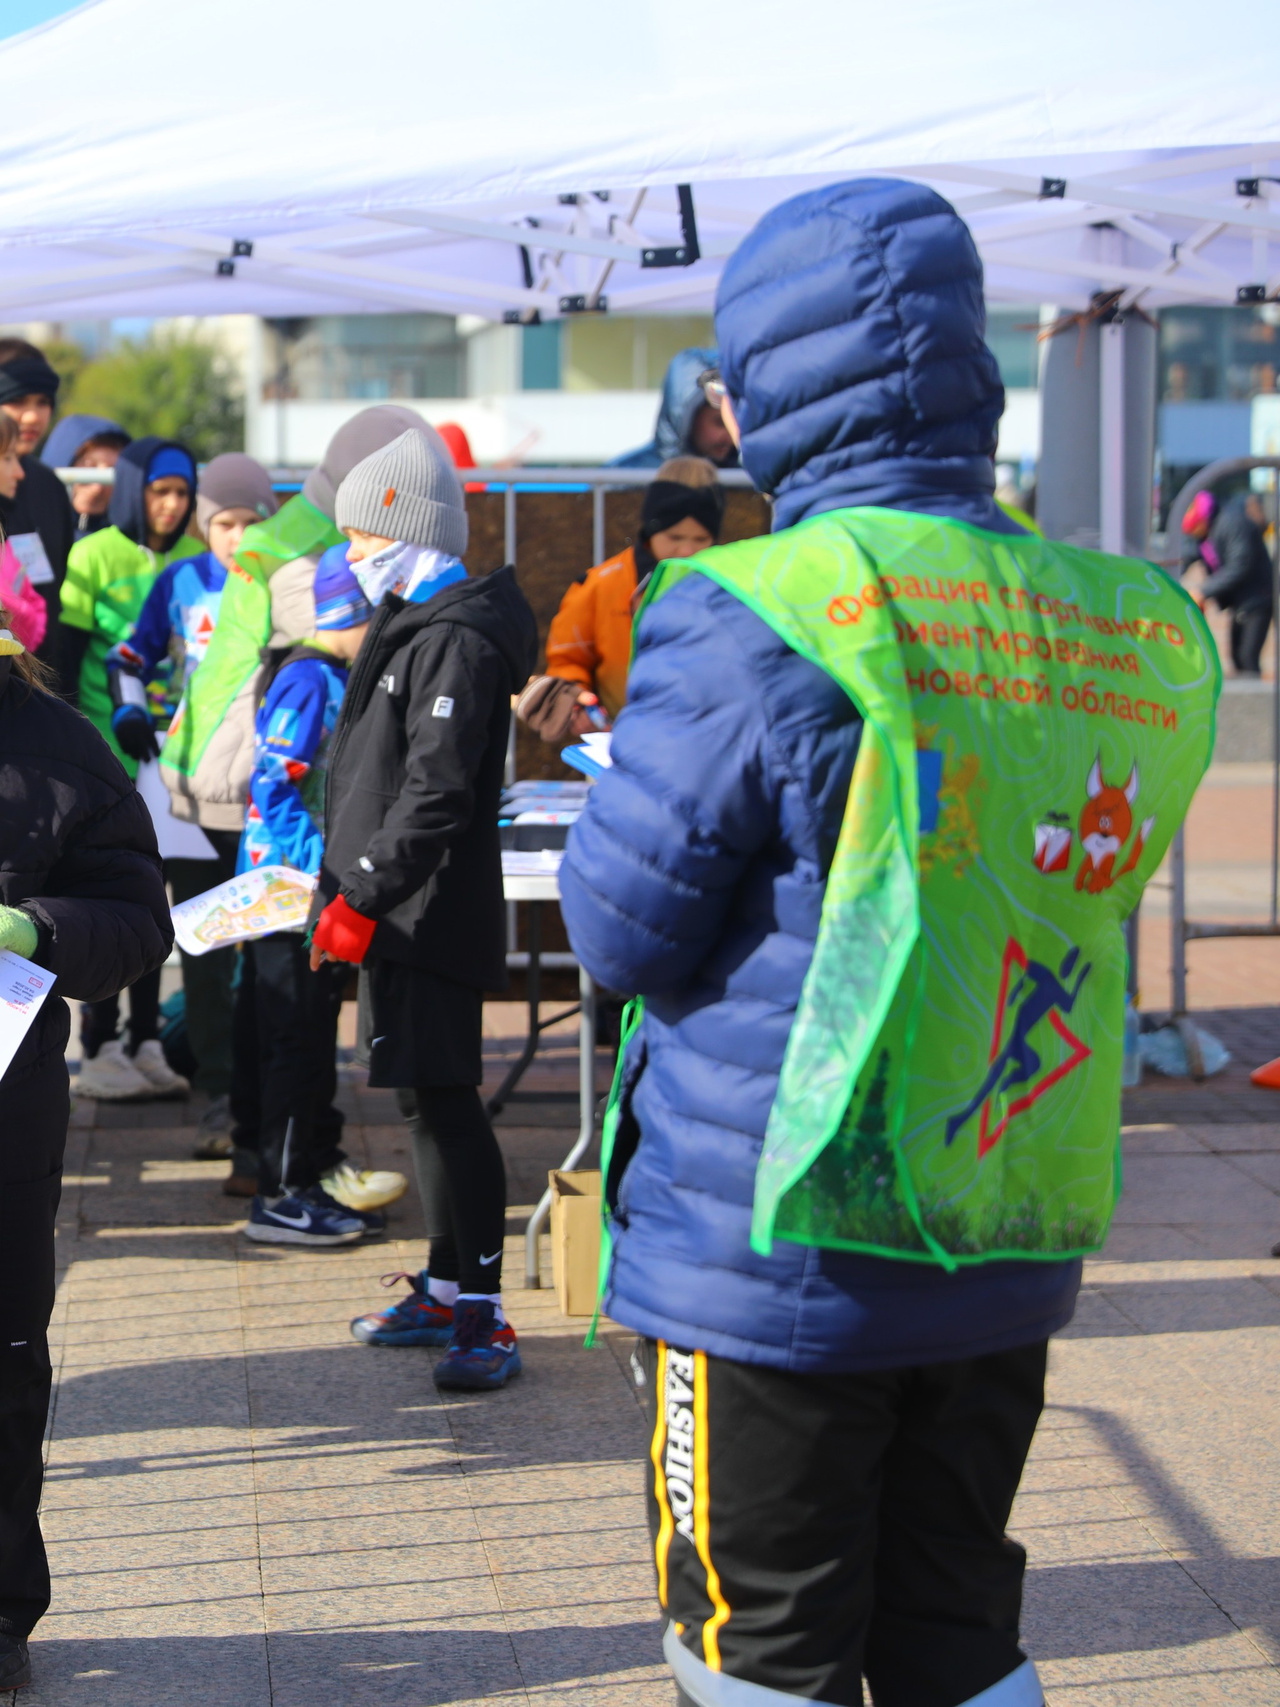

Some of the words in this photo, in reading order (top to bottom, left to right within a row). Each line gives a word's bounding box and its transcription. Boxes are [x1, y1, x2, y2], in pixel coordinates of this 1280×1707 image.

[998, 585, 1185, 647] спортивного
[904, 667, 1053, 706] новской
[1061, 681, 1179, 733] области
[665, 1347, 696, 1546] FASHION
